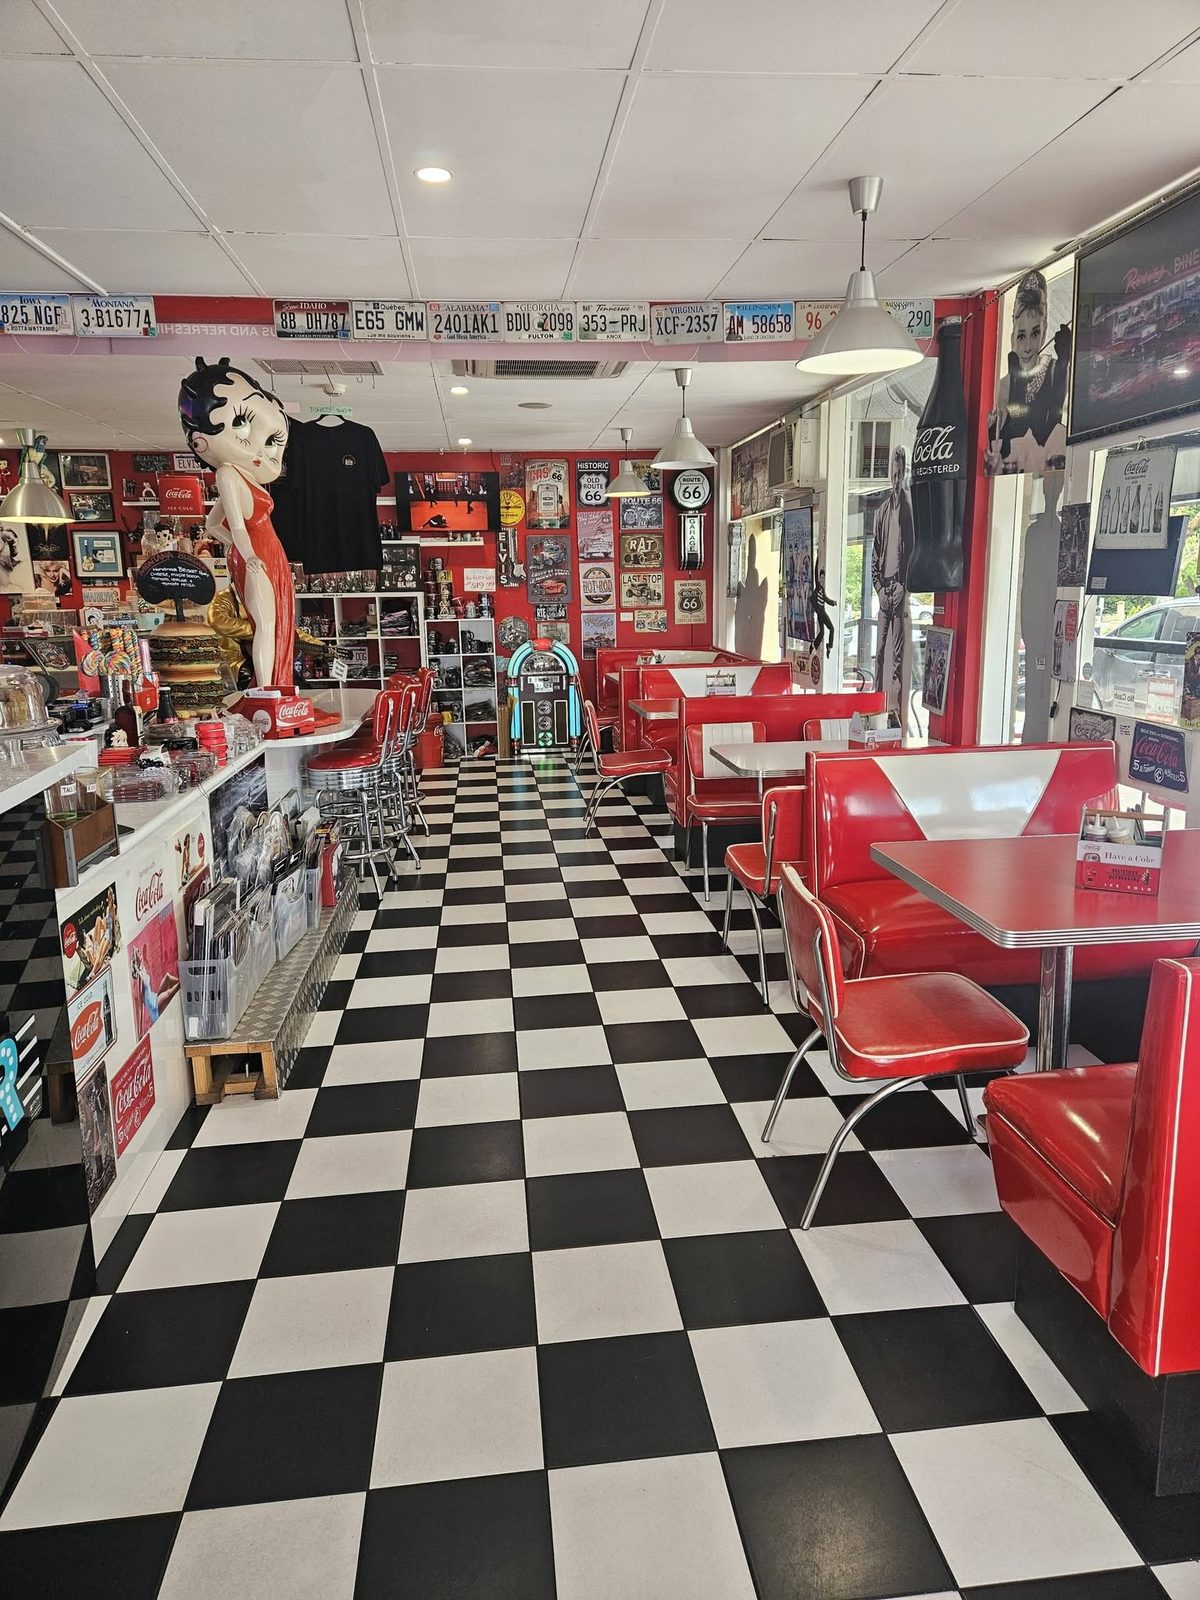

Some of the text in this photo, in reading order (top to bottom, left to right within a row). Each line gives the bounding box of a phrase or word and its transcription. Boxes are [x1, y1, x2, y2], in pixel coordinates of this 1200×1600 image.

[91, 299, 135, 308] MONTANA
[300, 302, 327, 310] IDAHO
[520, 304, 561, 312] GEORGIA
[595, 304, 630, 313] Tennessee
[668, 305, 705, 315] VIRGINIA
[742, 304, 777, 312] ILLINOIS
[1, 305, 62, 325] 825 NGF
[280, 311, 346, 331] 8B DH787
[354, 310, 425, 331] E65 GMW
[434, 313, 500, 334] 2401AK1
[506, 312, 574, 332] BDU 2098
[655, 313, 719, 336] XCF-2357
[729, 313, 792, 335] AM 58658
[577, 461, 609, 470] HISTORIC
[530, 466, 549, 480] GAS
[551, 472, 563, 481] 66
[165, 488, 193, 499] Coca-Cola
[585, 490, 602, 501] 66
[682, 486, 702, 500] 66
[621, 497, 662, 505] ROUTE 66
[688, 518, 696, 552] GARAGE
[629, 537, 655, 552] RAT
[498, 531, 508, 585] ELVIS
[397, 581, 417, 589] ELVIS
[622, 574, 662, 584] LAST STOP
[682, 597, 698, 610] 66
[537, 608, 546, 618] RTE
[558, 608, 566, 617] 66
[279, 701, 310, 720] Coca-Cola
[1134, 736, 1179, 769] Coca-Cola
[1132, 759, 1140, 771] 5
[1179, 771, 1186, 783] 5
[1105, 852, 1125, 860] Have
[1135, 855, 1157, 864] Coke
[135, 868, 164, 922] Coca-Cola
[74, 1006, 100, 1051] Coca-Cola
[115, 1050, 152, 1124] Coca-Cola
